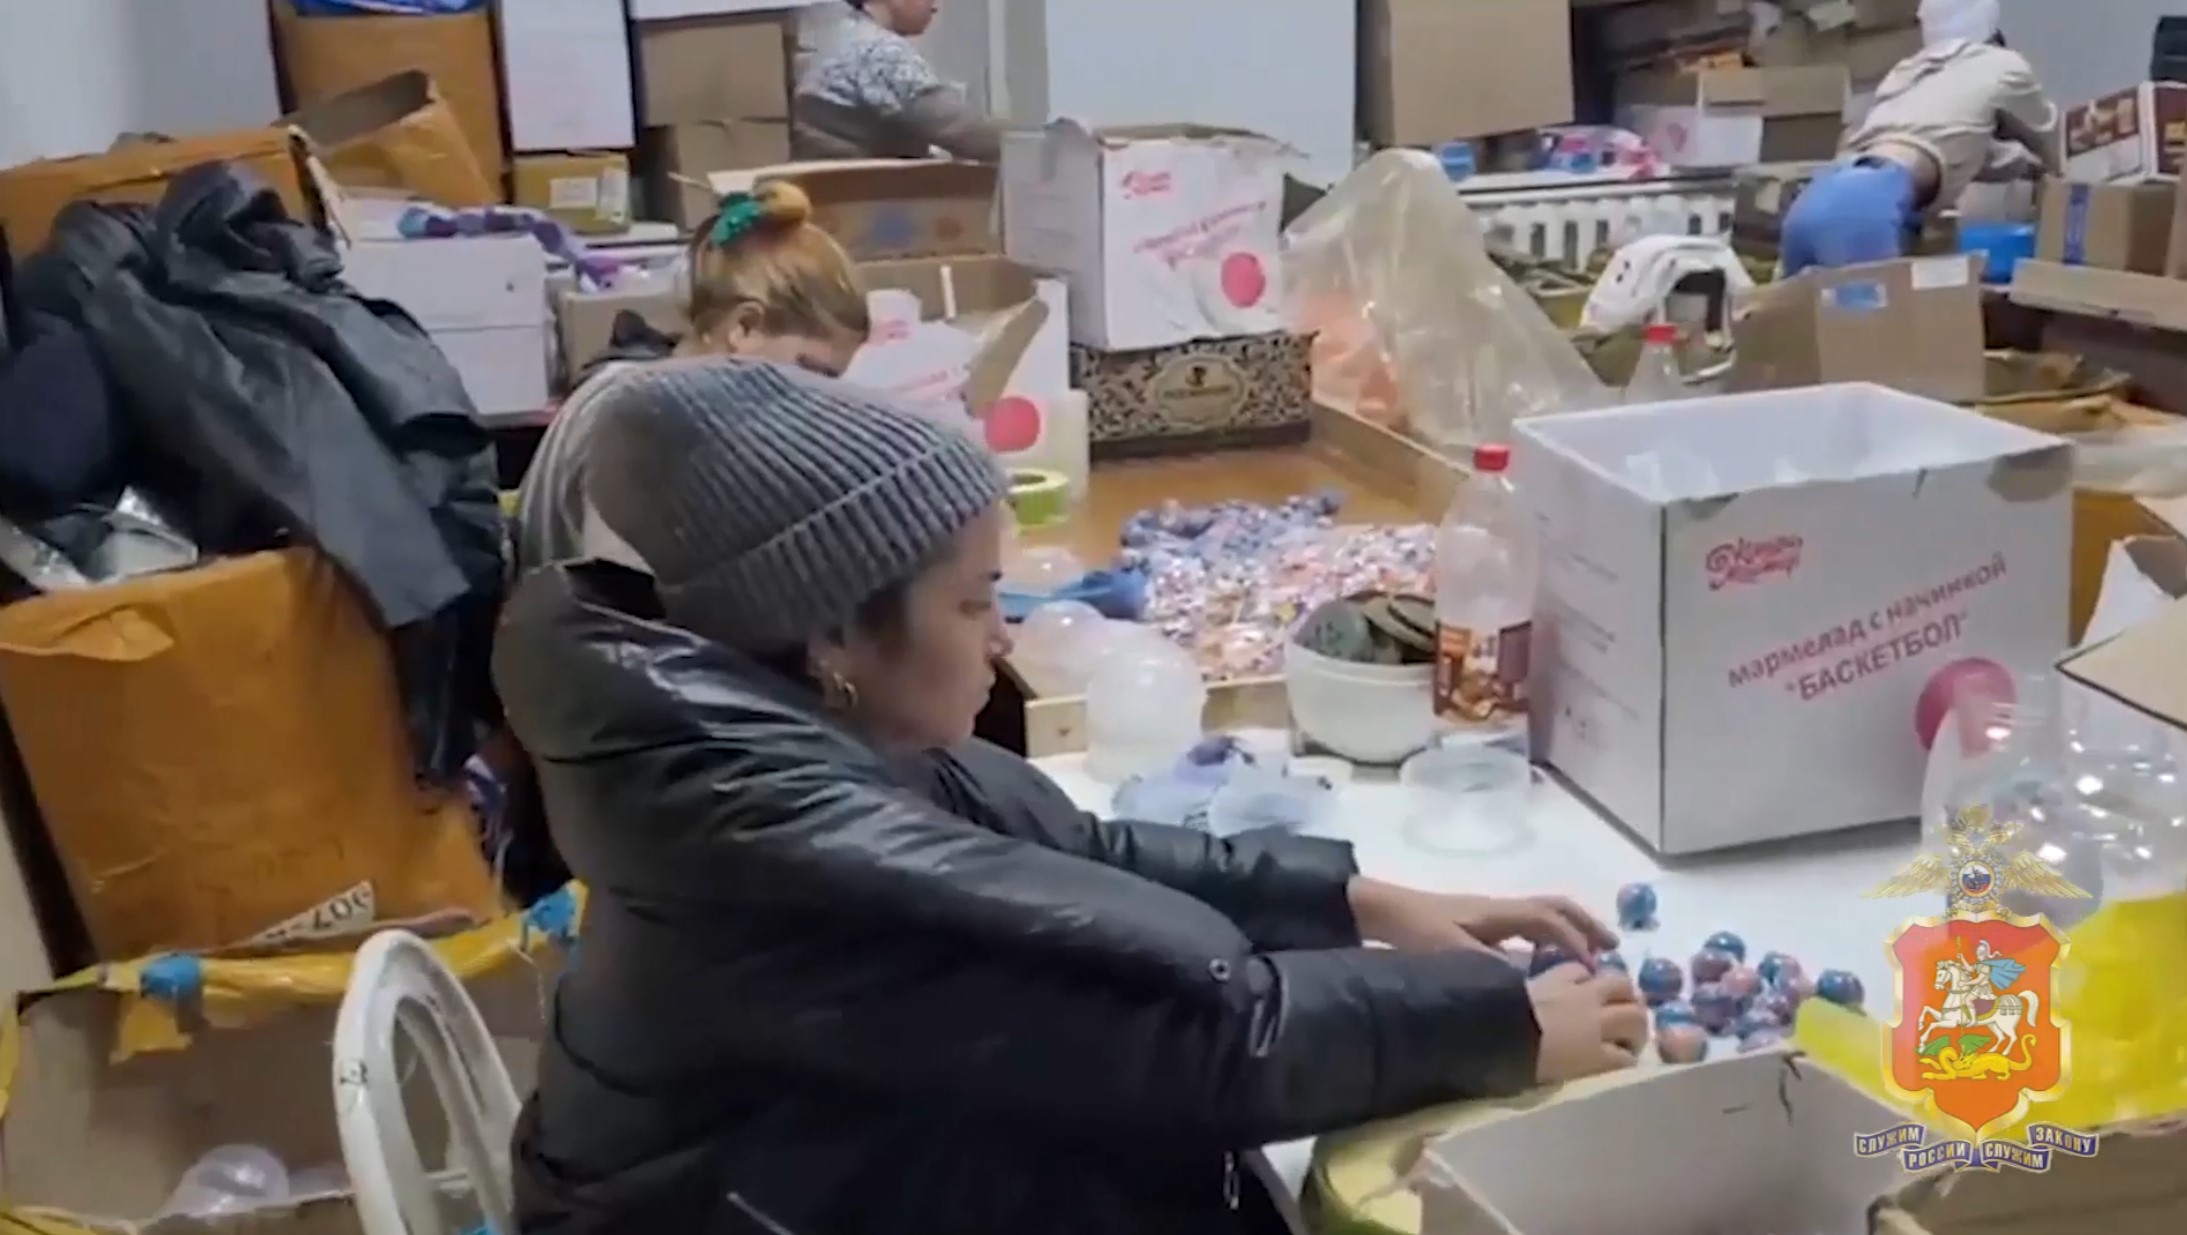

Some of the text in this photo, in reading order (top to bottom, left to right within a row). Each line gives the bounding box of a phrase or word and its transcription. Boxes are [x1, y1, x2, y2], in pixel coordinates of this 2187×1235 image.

[1728, 617, 1867, 688] мармелад
[1869, 611, 1884, 631] с
[1886, 551, 2008, 626] начинкой
